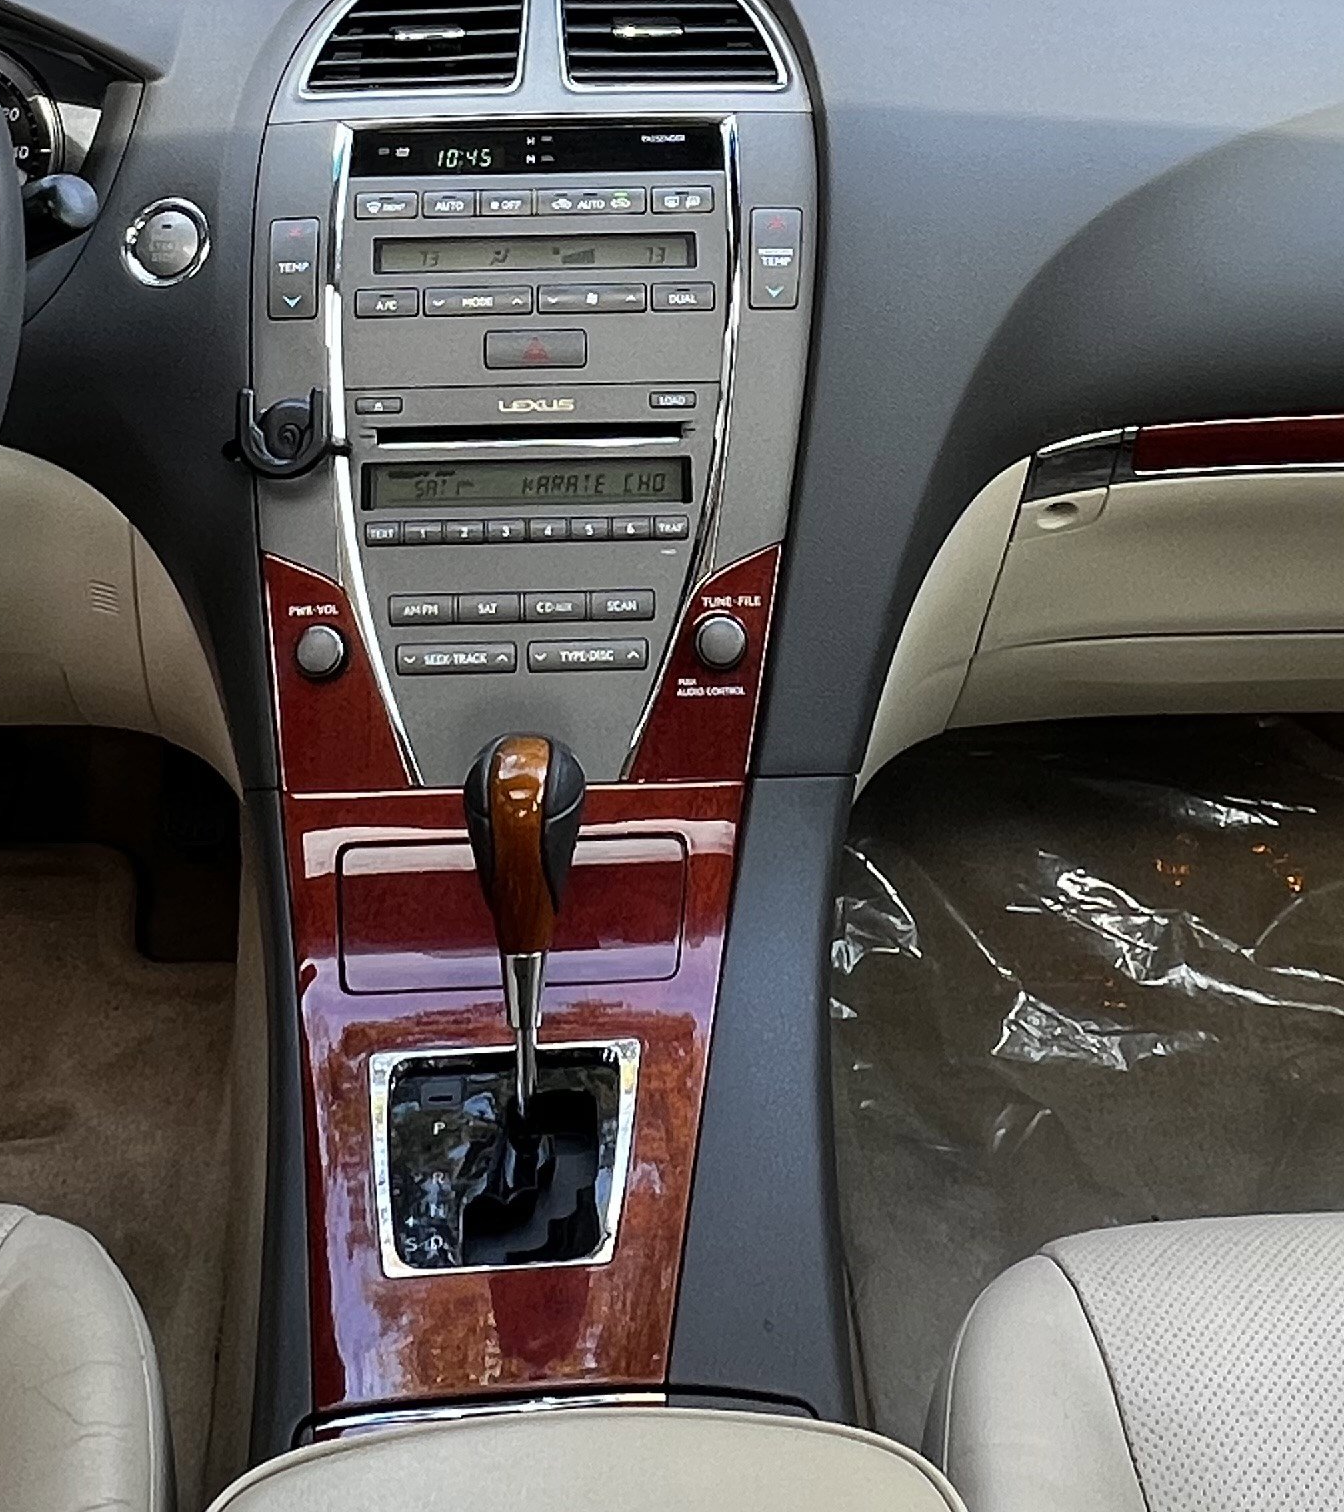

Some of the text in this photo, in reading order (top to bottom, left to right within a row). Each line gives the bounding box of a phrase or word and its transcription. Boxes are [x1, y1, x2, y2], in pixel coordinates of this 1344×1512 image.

[437, 148, 492, 168] 10:45
[434, 200, 464, 211] AUTO
[501, 200, 522, 210] OFF
[577, 199, 605, 209] AUTO
[278, 261, 310, 274] TEMP
[760, 256, 792, 267] TEMP
[375, 299, 398, 311] A/C
[462, 296, 494, 308] MODE
[668, 293, 697, 305] DUAL
[498, 398, 575, 413] LEXUS
[659, 394, 686, 406] LOAD
[419, 527, 427, 539] 1
[460, 526, 469, 539] 2
[502, 525, 511, 538] 3
[544, 523, 552, 536] 4
[585, 523, 594, 536] 5
[626, 522, 635, 535] 6
[478, 602, 498, 614] SAT
[606, 600, 638, 612] SCAN
[676, 685, 746, 697] AUDIO CONTROL
[433, 1121, 446, 1136] P
[432, 1171, 444, 1185] R
[404, 1236, 418, 1252] S
[431, 1234, 444, 1251] D
